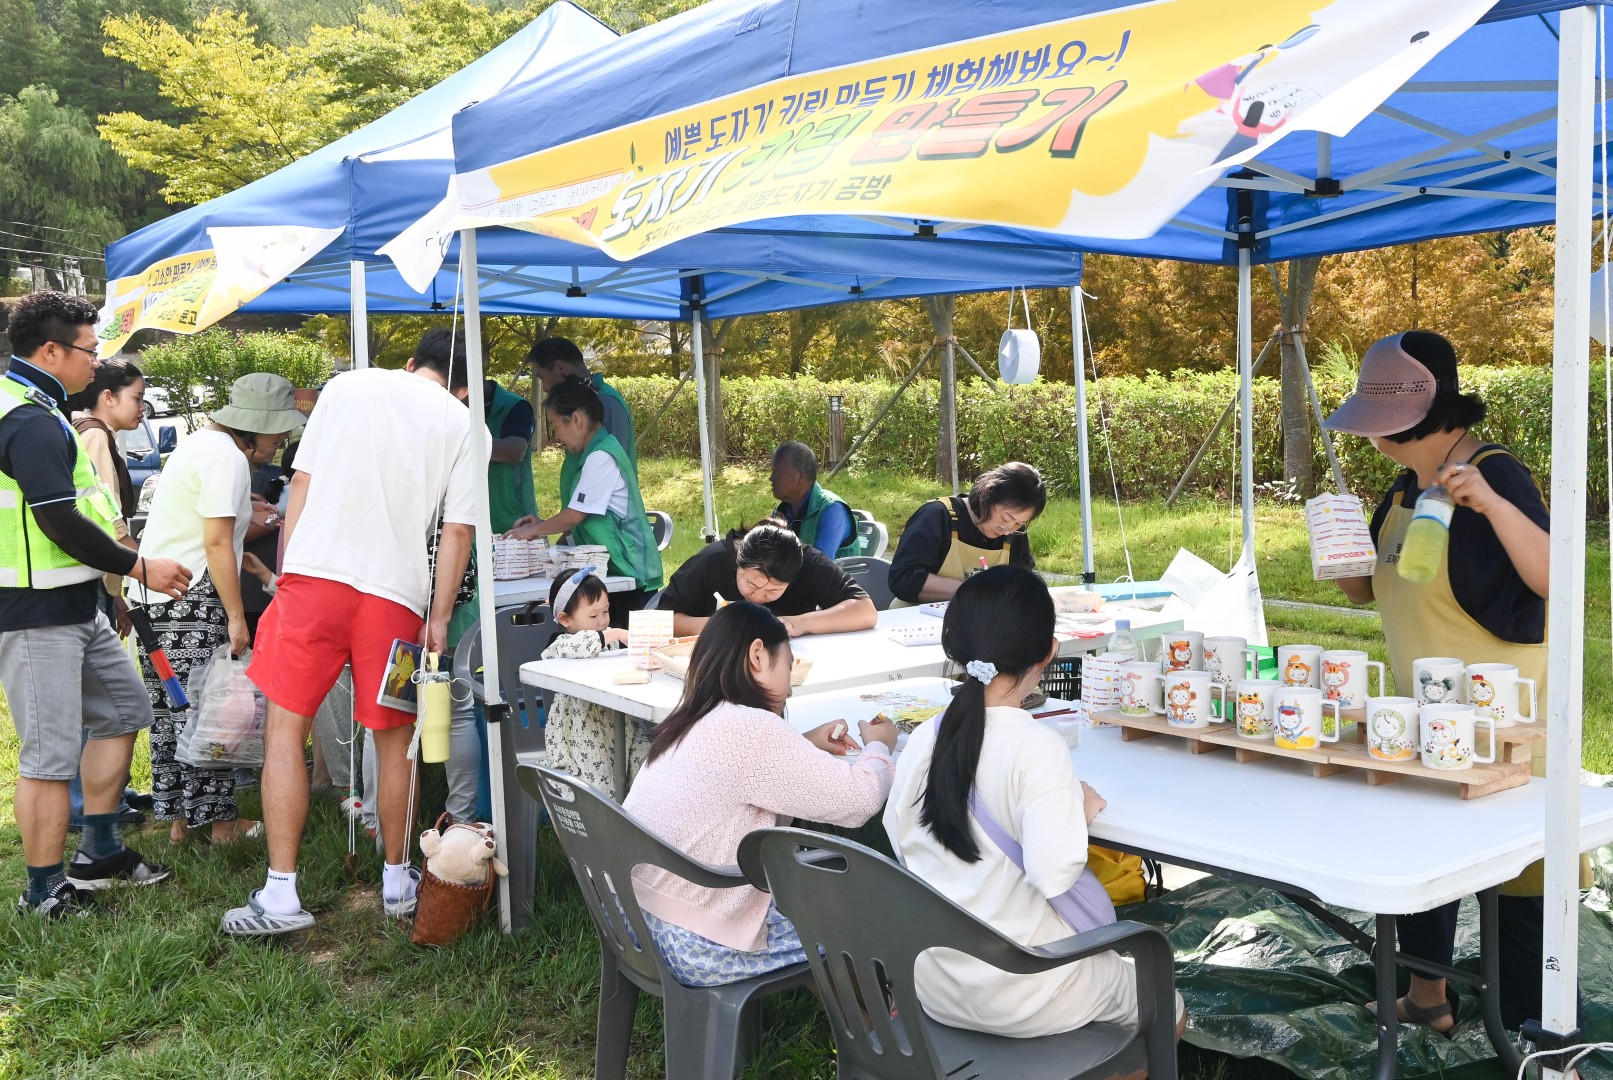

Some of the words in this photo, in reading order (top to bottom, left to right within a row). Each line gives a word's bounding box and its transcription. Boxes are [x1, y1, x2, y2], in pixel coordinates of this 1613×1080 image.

[664, 121, 702, 165] 예쁜
[705, 99, 774, 152] 도자기
[779, 88, 835, 126] 키링
[835, 70, 916, 110] 만들기
[919, 29, 1131, 98] 체험해봐요~!
[602, 145, 751, 243] 도자기
[722, 110, 873, 194] 키링
[849, 80, 1128, 166] 만들기
[835, 174, 893, 201] 공방
[1327, 551, 1367, 561] POPCORN
